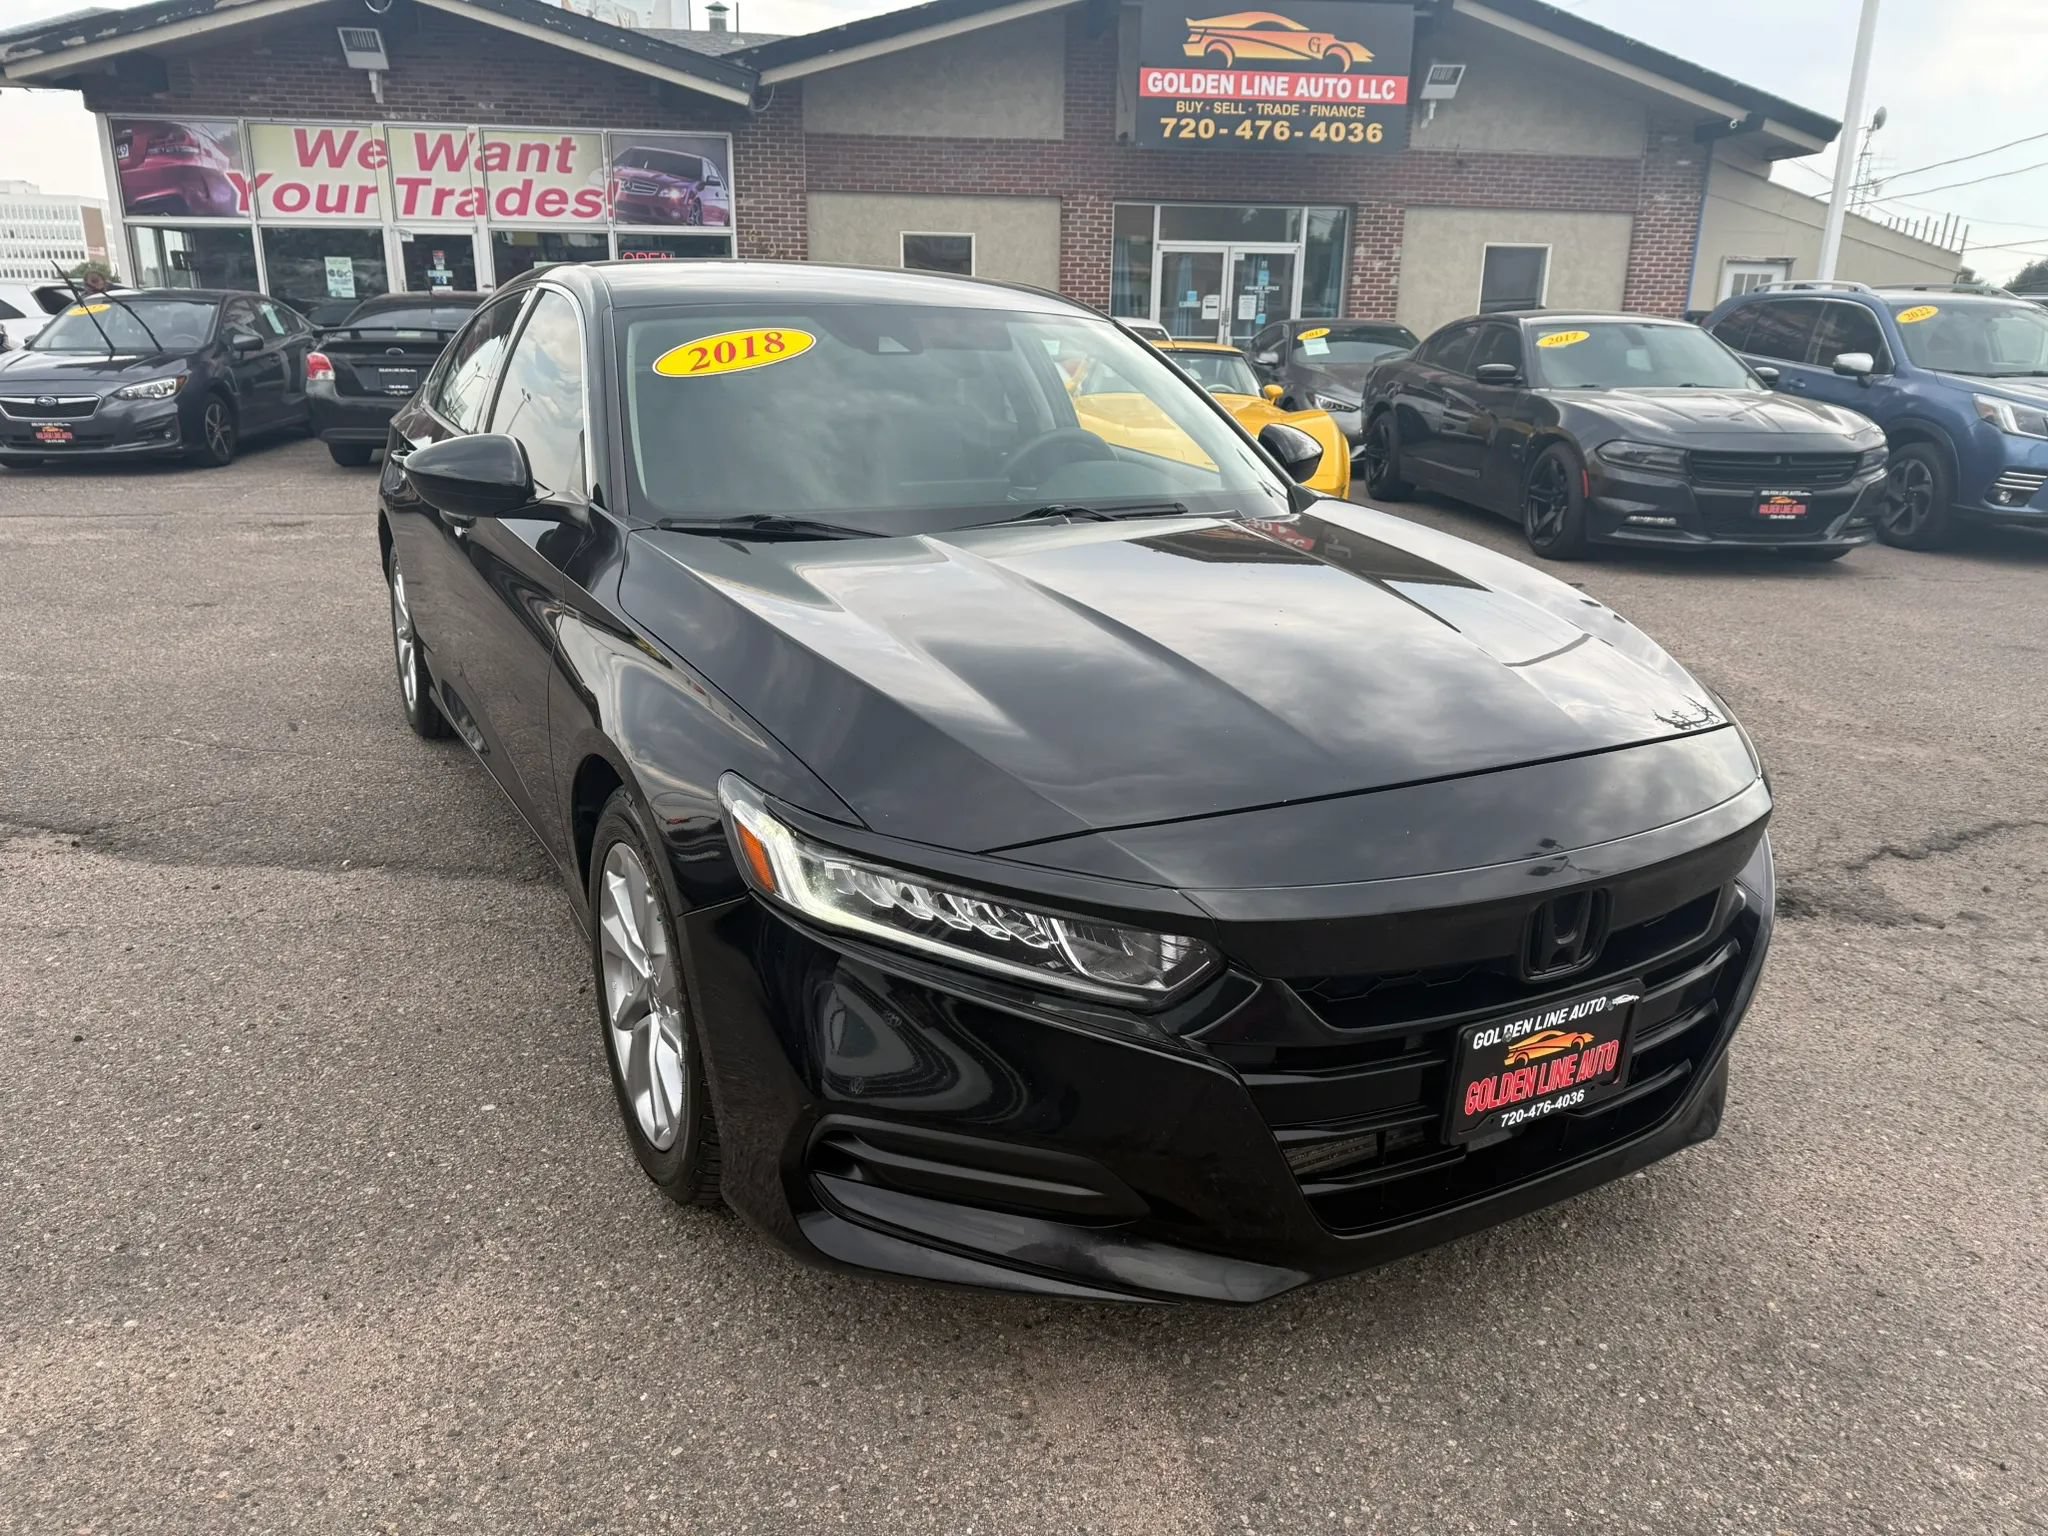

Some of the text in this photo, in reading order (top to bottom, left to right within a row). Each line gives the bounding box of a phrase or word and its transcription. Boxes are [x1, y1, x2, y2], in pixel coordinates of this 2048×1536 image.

[1147, 71, 1396, 100] GOLDEN LINE AUTO LLC
[1175, 100, 1366, 118] BUY SELL TRADE FINANCE
[293, 127, 577, 175] We Want
[226, 171, 621, 219] Your Trades!
[687, 331, 786, 372] 2018
[1472, 996, 1607, 1050] GOLDEN LINE AUTO
[1464, 1039, 1619, 1116] GOLDEN LINE AUTO
[1501, 1089, 1585, 1128] 720-476-4036
